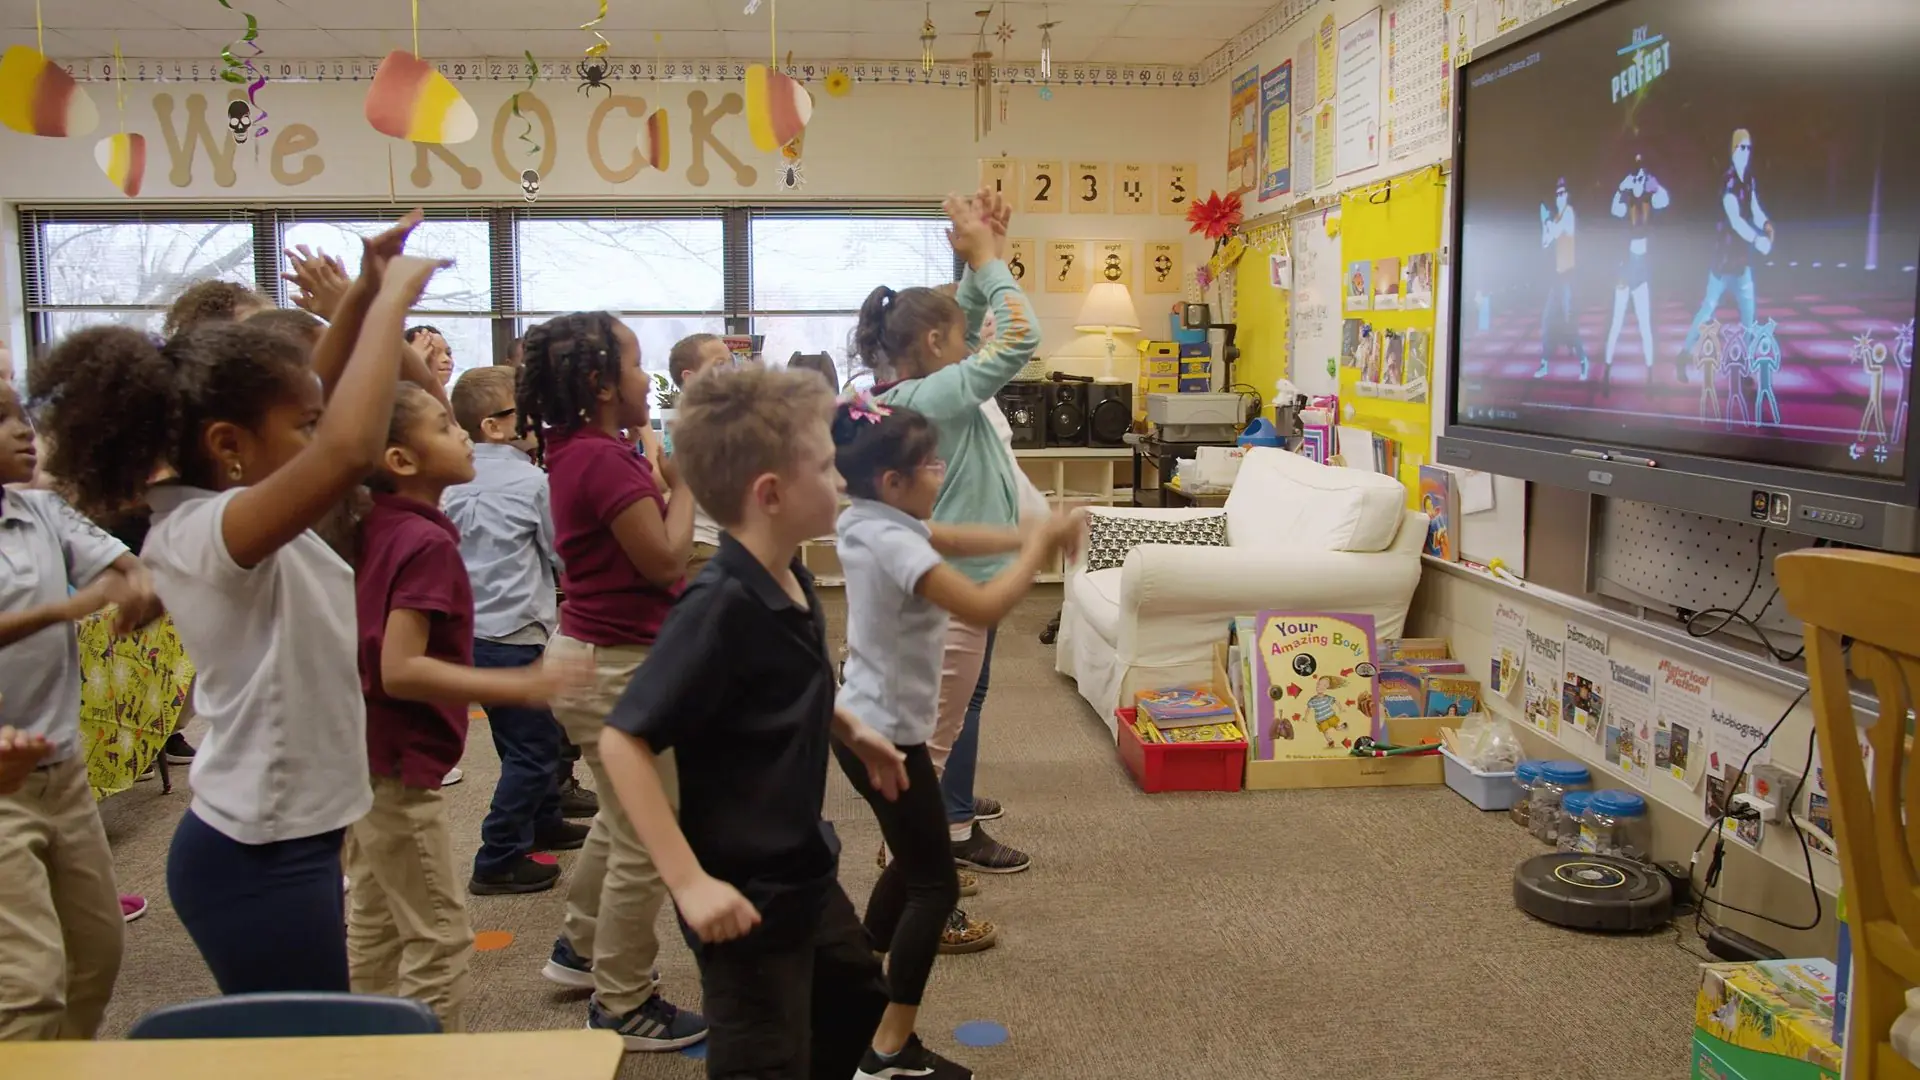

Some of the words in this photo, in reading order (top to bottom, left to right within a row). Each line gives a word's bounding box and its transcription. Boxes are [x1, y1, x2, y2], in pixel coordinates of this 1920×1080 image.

[103, 64, 110, 75] 0
[138, 64, 145, 74] 2
[156, 64, 163, 75] 3
[174, 64, 181, 74] 4
[191, 64, 199, 74] 5
[210, 64, 217, 74] 6
[263, 64, 270, 74] 9
[280, 64, 291, 74] 10
[297, 64, 307, 74] 11
[316, 64, 325, 74] 12
[333, 64, 343, 74] 13
[351, 64, 361, 74] 14
[454, 64, 466, 74] 20
[471, 64, 481, 74] 21
[490, 64, 501, 74] 22
[507, 64, 518, 74] 23
[541, 64, 553, 74] 25
[560, 64, 571, 74] 26
[612, 64, 623, 74] 29
[629, 64, 641, 75] 30
[647, 64, 656, 74] 31
[664, 64, 675, 74] 32
[681, 64, 693, 74] 33
[699, 64, 710, 74] 34
[716, 64, 727, 74] 35
[734, 64, 745, 74] 36
[786, 65, 797, 75] 39
[802, 65, 814, 75] 40
[820, 65, 829, 75] 41
[854, 66, 865, 75] 43
[871, 66, 882, 76] 44
[888, 66, 899, 76] 45
[905, 66, 916, 77] 46
[939, 69, 949, 79] 48
[956, 70, 967, 80] 49
[991, 67, 999, 77] 51
[1007, 67, 1018, 77] 52
[1024, 67, 1035, 77] 53
[1058, 69, 1068, 79] 55
[1074, 69, 1085, 79] 56
[1089, 69, 1100, 79] 57
[1106, 69, 1117, 79] 58
[1122, 69, 1134, 79] 59
[1139, 70, 1151, 80] 60
[1156, 70, 1165, 80] 61
[1172, 71, 1183, 81] 62
[1188, 71, 1199, 81] 63
[1611, 41, 1670, 104] PERFECT
[152, 88, 325, 188] We
[1080, 163, 1097, 171] three
[1034, 174, 1051, 201] 2
[1080, 174, 1098, 202] 3
[1124, 181, 1143, 203] 4
[1169, 176, 1187, 203] 5
[1104, 243, 1122, 251] eight
[1009, 252, 1025, 281] 6
[1057, 254, 1075, 281] 7
[1104, 254, 1122, 281] 8
[1154, 254, 1173, 282] 9
[1275, 622, 1318, 637] Your
[1526, 629, 1561, 653] REALISTIC
[1271, 633, 1328, 655] Amazing
[1332, 632, 1364, 657] Body
[1531, 644, 1557, 661] FICTION
[1658, 659, 1710, 687] Historical
[1665, 674, 1702, 695] Fiction
